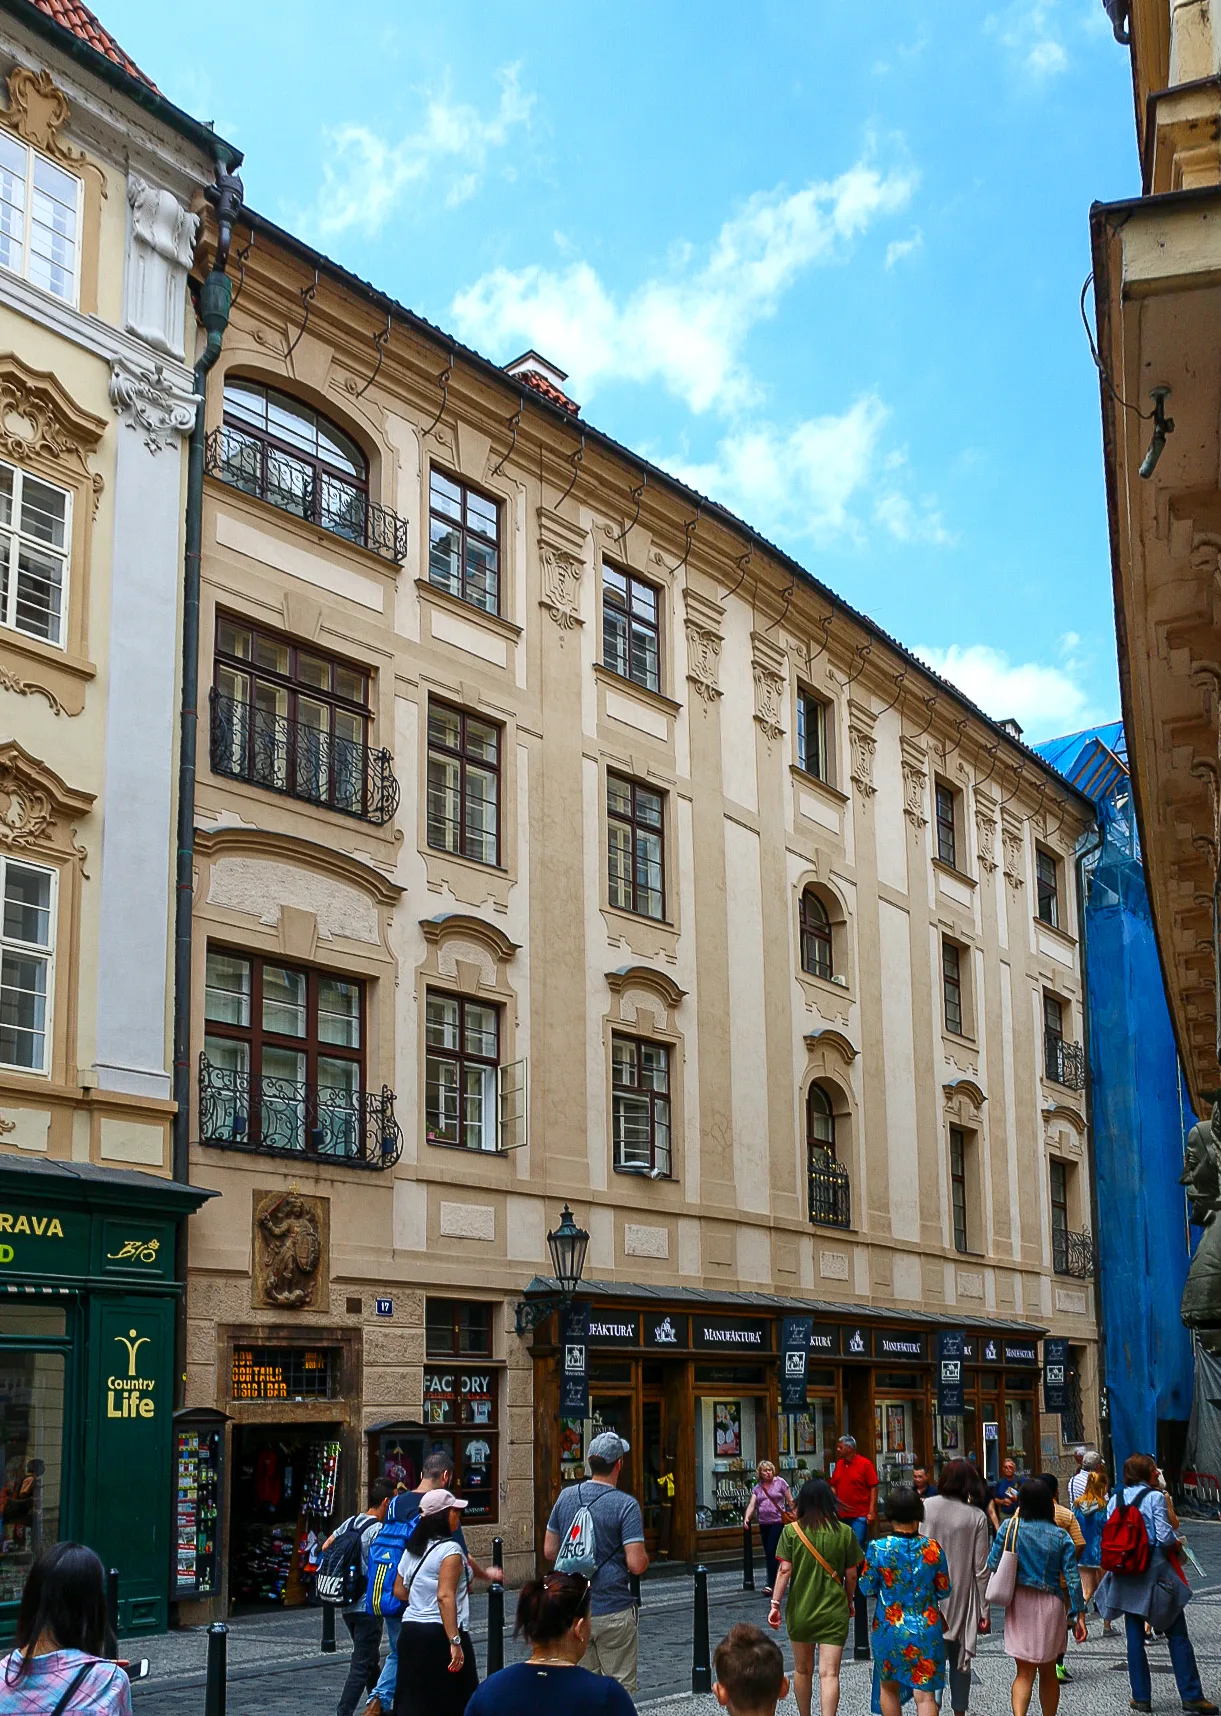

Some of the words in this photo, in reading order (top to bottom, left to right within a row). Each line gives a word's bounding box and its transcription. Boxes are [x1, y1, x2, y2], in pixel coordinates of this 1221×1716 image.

[381, 1301, 390, 1312] 17
[703, 1328, 761, 1343] MANUFAKTURA
[107, 1376, 155, 1390] Country
[423, 1375, 489, 1393] FACORY
[107, 1391, 155, 1418] Life
[317, 1574, 344, 1596] NIKE
